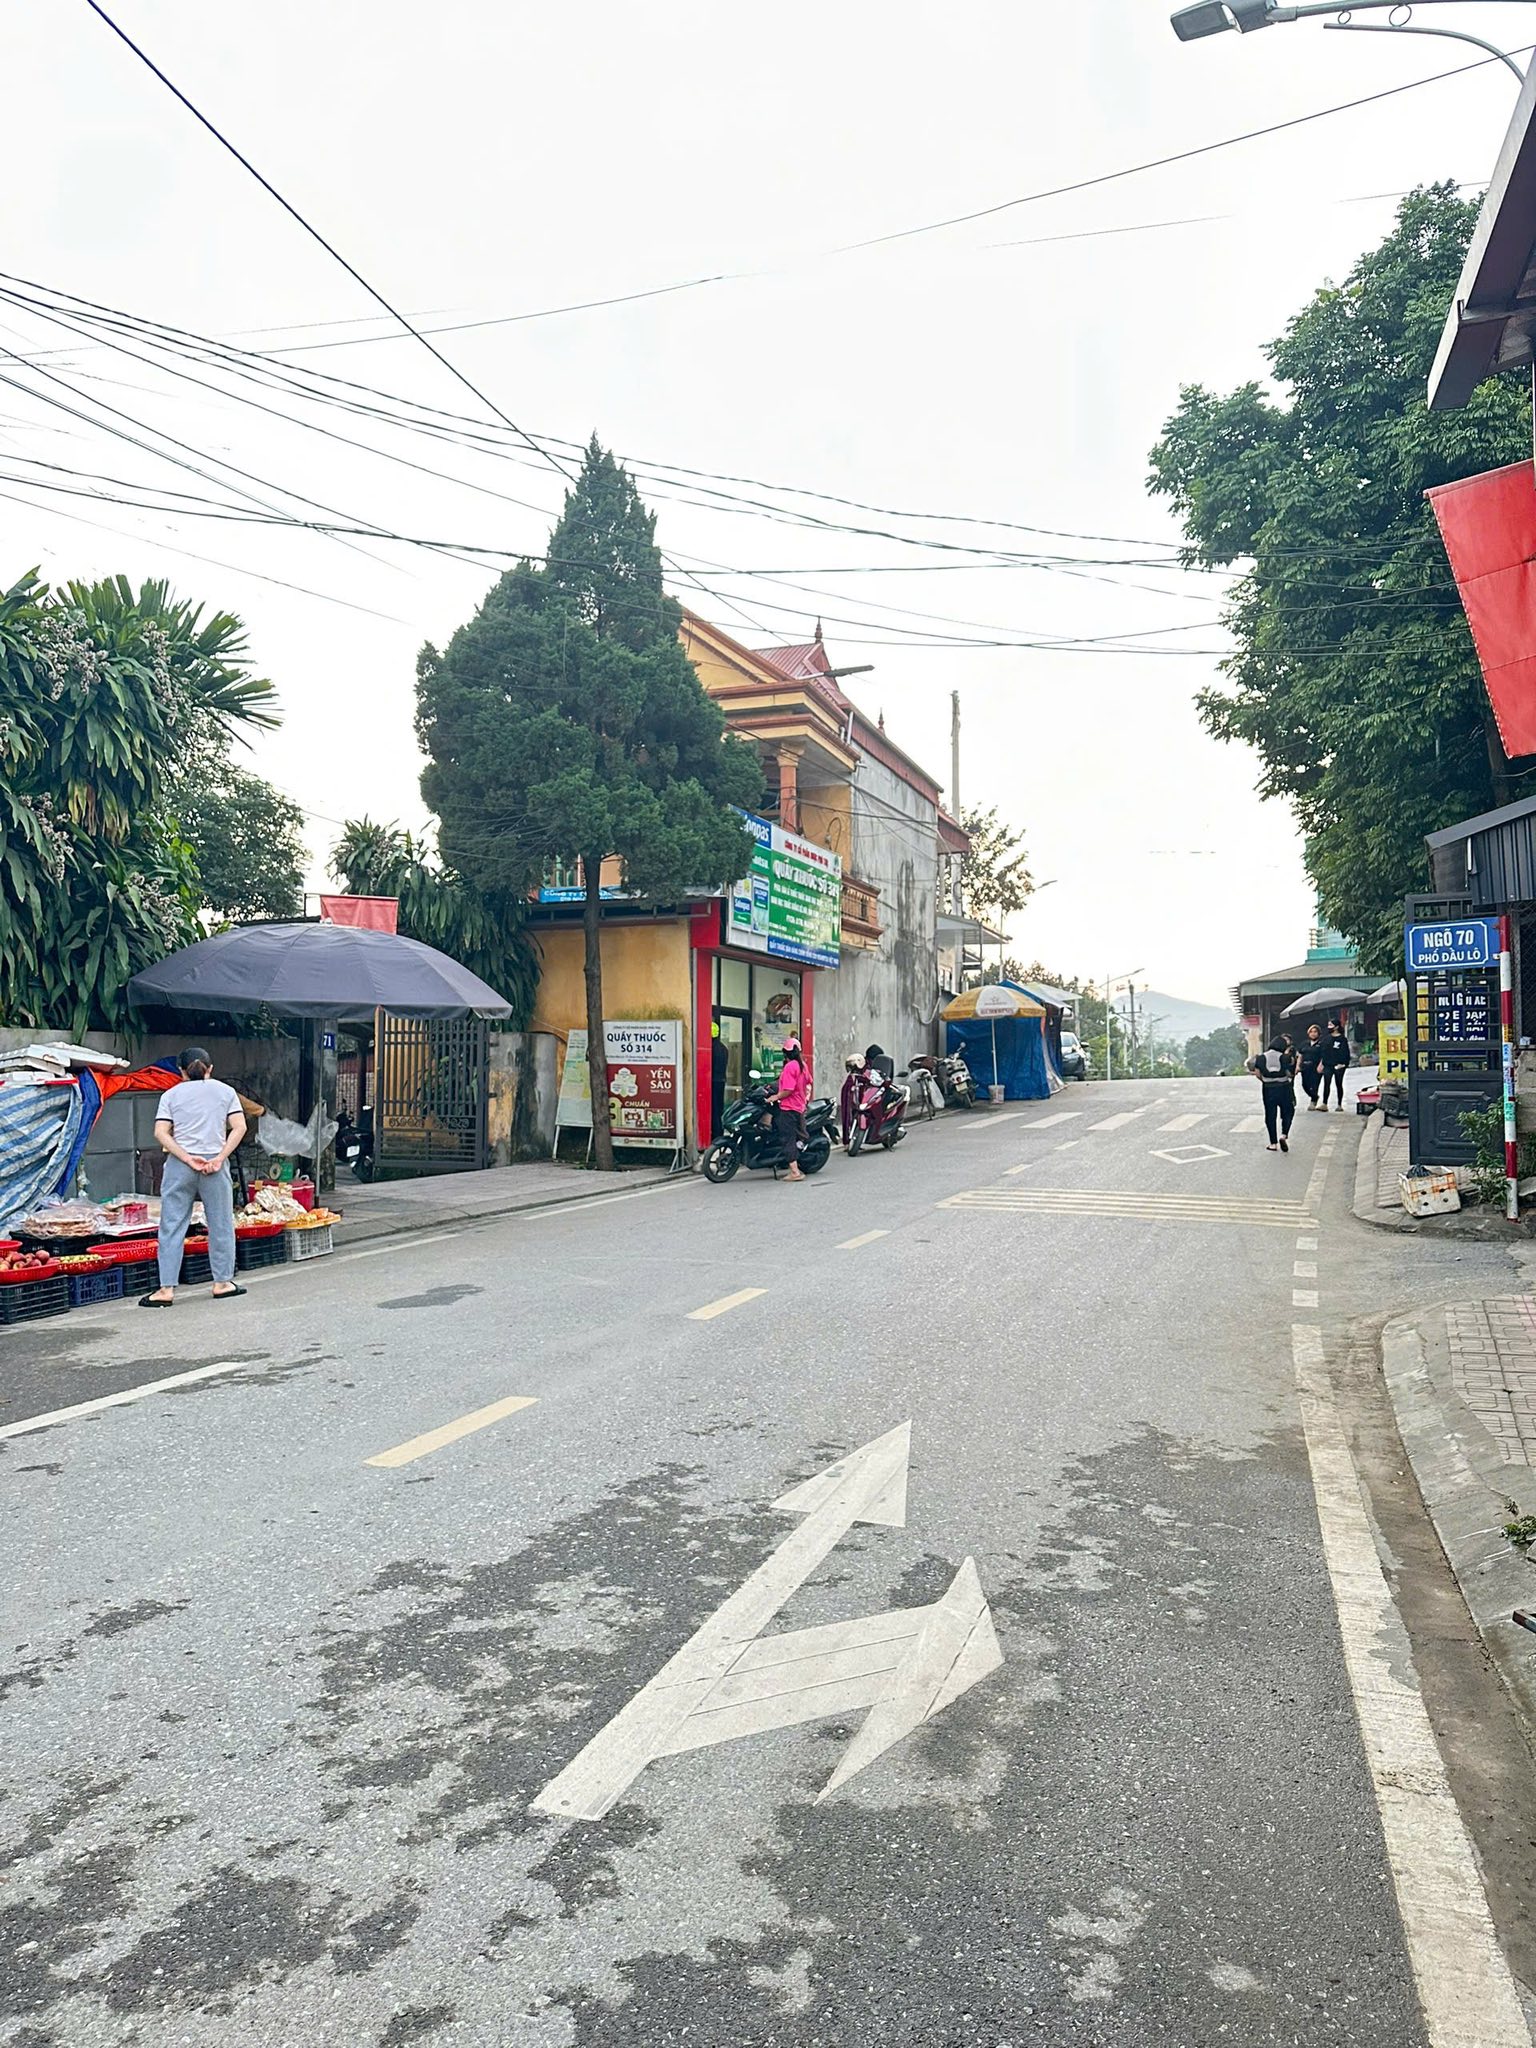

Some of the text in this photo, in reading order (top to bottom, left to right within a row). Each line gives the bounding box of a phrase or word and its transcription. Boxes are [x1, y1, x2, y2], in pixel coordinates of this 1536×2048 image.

[1424, 928, 1474, 948] NGÕ 70
[1418, 947, 1480, 964] PHỐ ĐẦU LÔ
[634, 1031, 666, 1041] THUỐC
[621, 1041, 633, 1052] SỐ
[650, 1067, 671, 1078] YẾN
